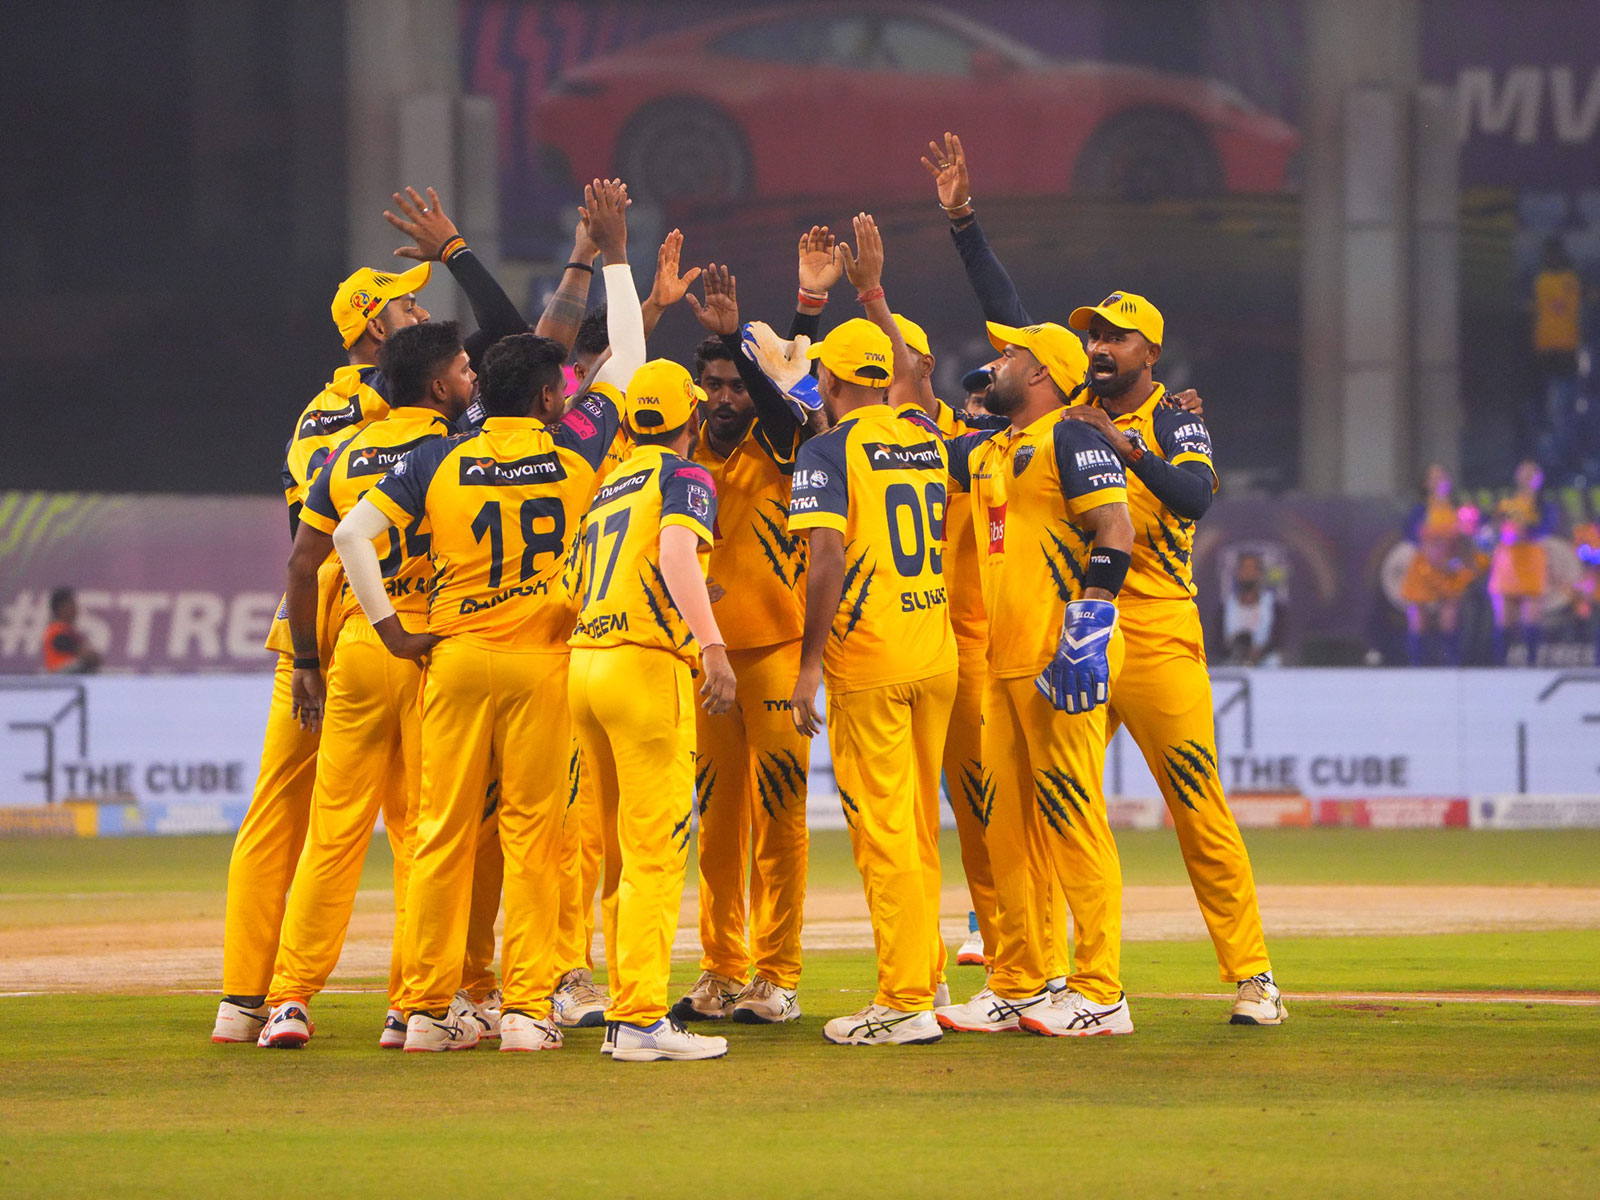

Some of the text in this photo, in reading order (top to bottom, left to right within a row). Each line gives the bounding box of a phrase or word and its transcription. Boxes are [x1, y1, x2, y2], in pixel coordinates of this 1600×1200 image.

[864, 352, 886, 363] TYKA
[637, 396, 660, 405] TYKA
[378, 450, 411, 464] nuv
[1075, 450, 1112, 467] HELL
[494, 461, 557, 480] nuvama
[792, 470, 808, 487] ELL
[885, 482, 947, 578] 09
[990, 520, 1005, 543] ibis
[470, 497, 567, 590] 18
[2, 590, 280, 662] #STRE
[763, 700, 792, 711] TYK
[63, 761, 244, 797] THE CUBE
[1229, 756, 1409, 788] THE CUBE
